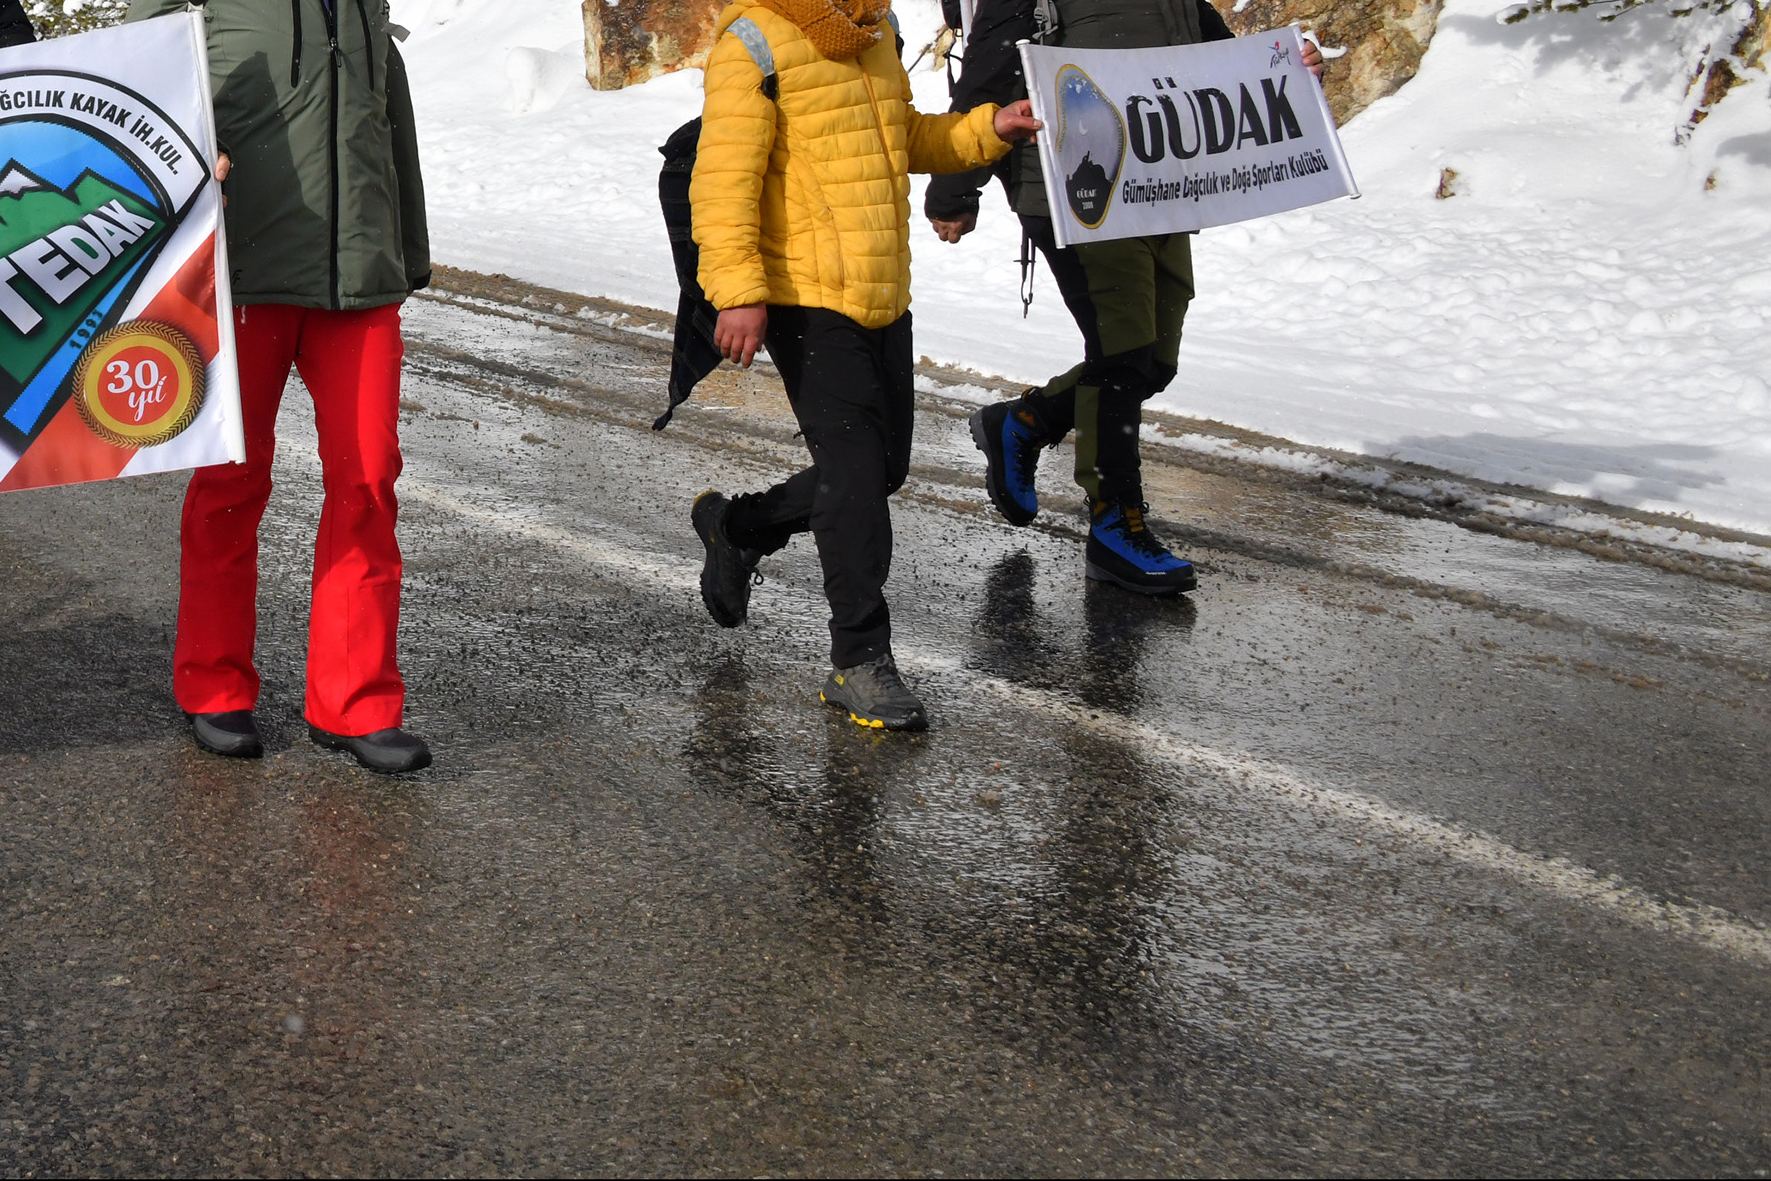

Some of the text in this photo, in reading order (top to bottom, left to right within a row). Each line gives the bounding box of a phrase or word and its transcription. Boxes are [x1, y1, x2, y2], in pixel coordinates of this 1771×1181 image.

[69, 92, 133, 129] KAYAK
[128, 114, 183, 176] İH.KUL.
[1125, 75, 1303, 164] GÜDAK
[1122, 148, 1329, 207] Gümüşhane Dağcılık ve Doğa Sporları Kulübü
[106, 359, 159, 394] 30
